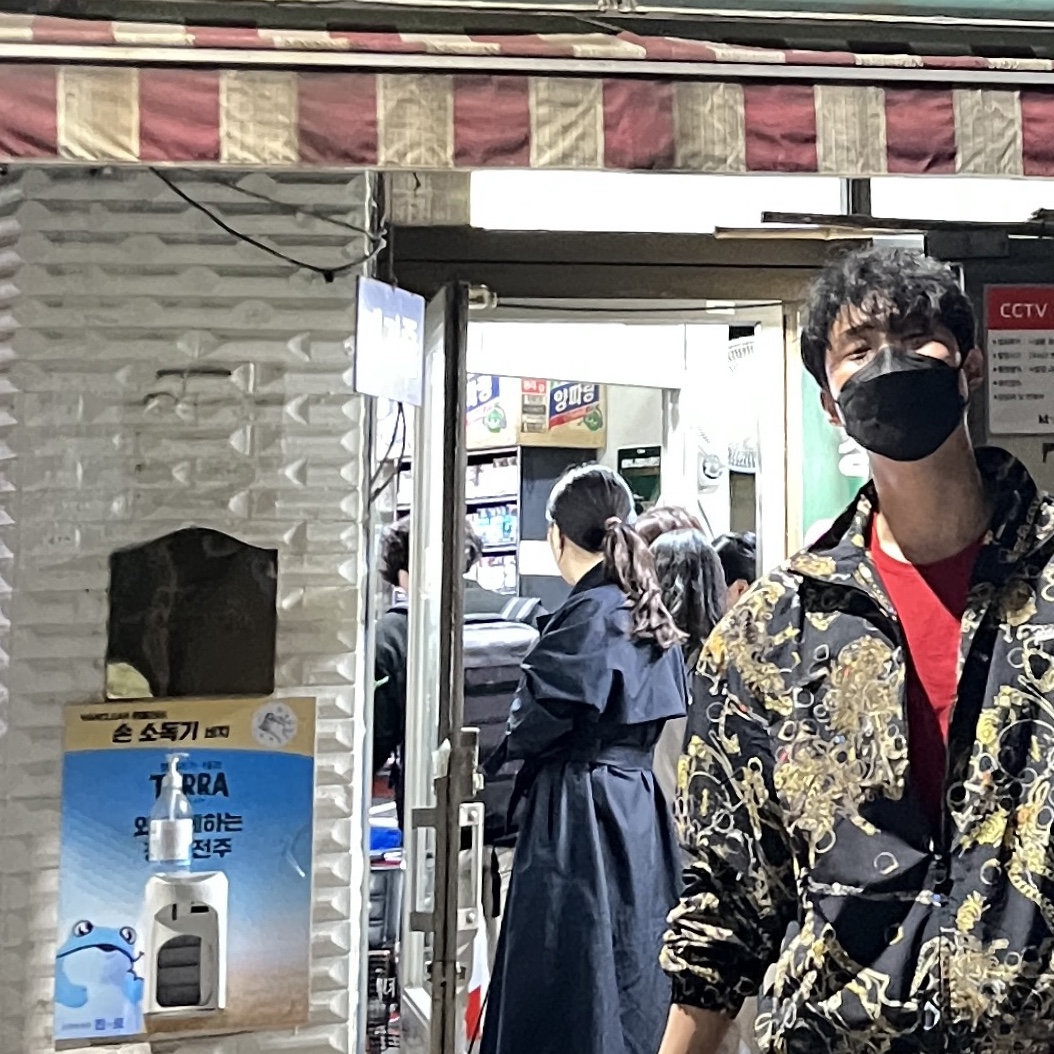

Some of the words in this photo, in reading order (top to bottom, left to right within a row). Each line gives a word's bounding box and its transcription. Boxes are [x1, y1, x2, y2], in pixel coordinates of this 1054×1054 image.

[1000, 302, 1047, 318] CCTV
[112, 722, 132, 743] 손
[138, 720, 199, 742] 소독기
[149, 772, 228, 798] TRRA
